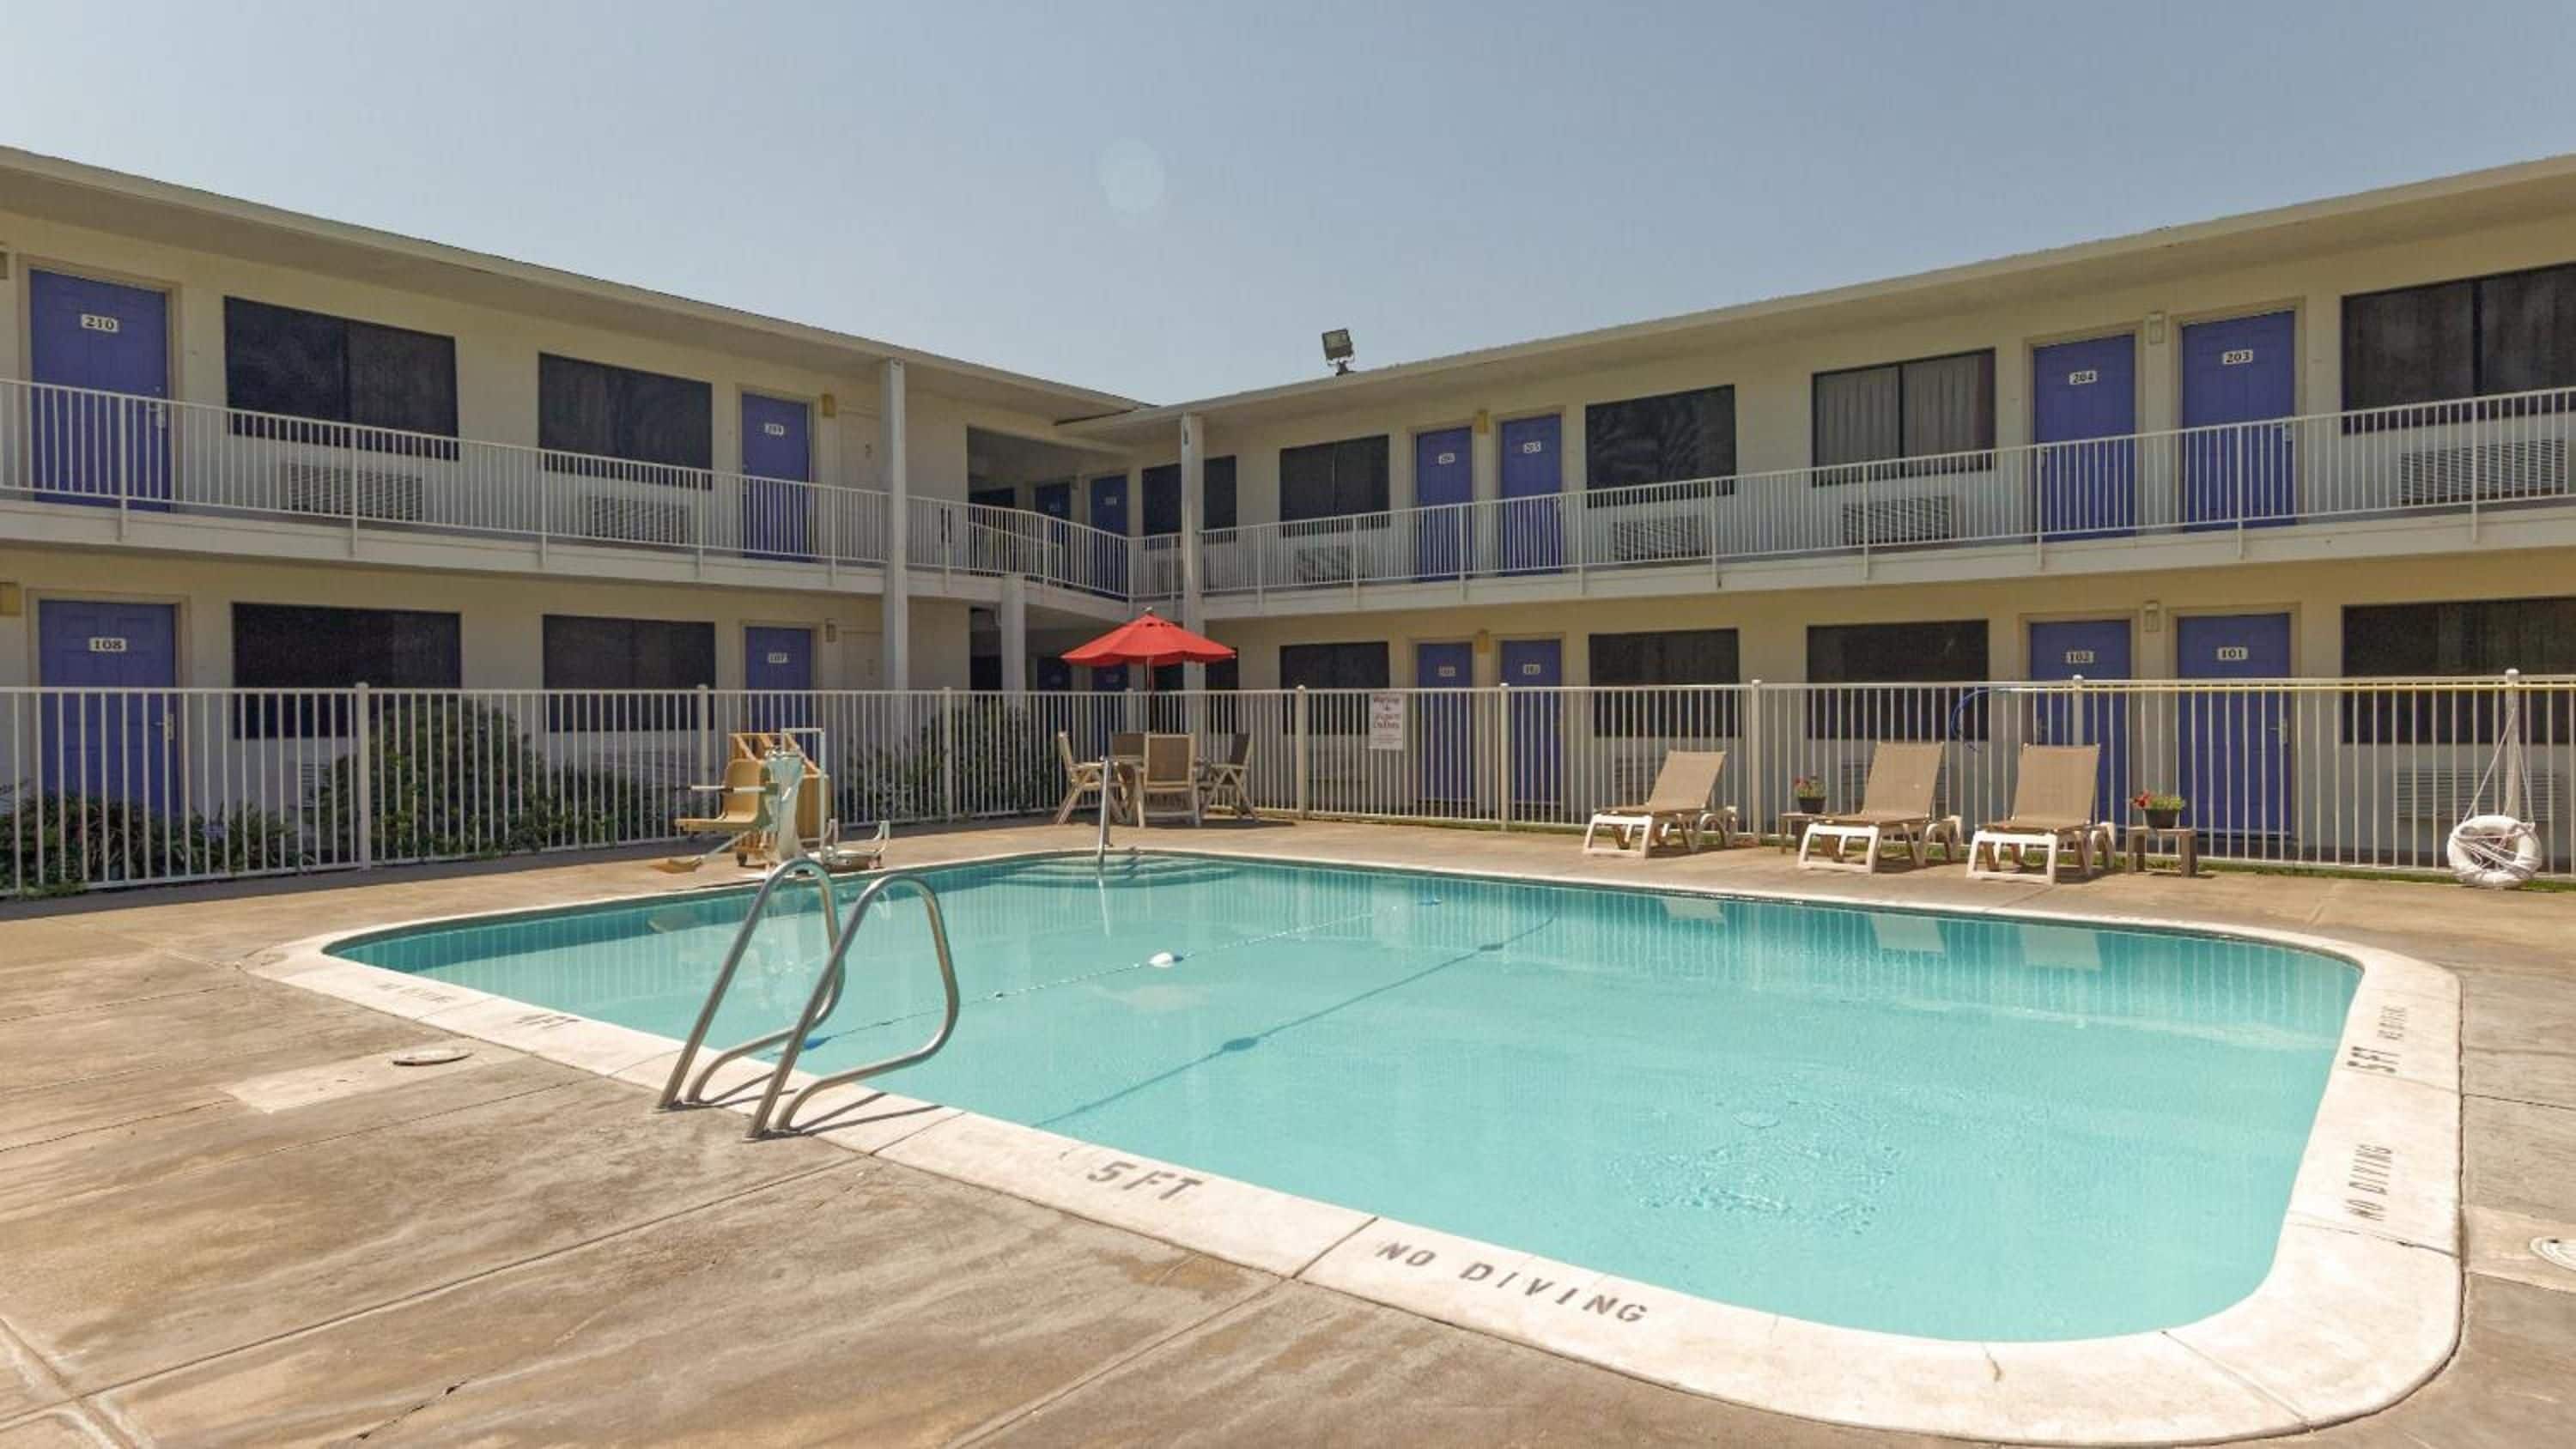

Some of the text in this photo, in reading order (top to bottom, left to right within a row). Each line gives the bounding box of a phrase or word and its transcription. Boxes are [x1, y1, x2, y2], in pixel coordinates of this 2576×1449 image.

[84, 315, 117, 331] 210
[2224, 350, 2251, 364] 203
[94, 639, 125, 651] 108
[2221, 647, 2245, 660] 101
[1085, 1160, 1205, 1201] 5FT
[2345, 1143, 2392, 1222] NO DIVING
[1375, 1241, 1649, 1322] NO DIVING
